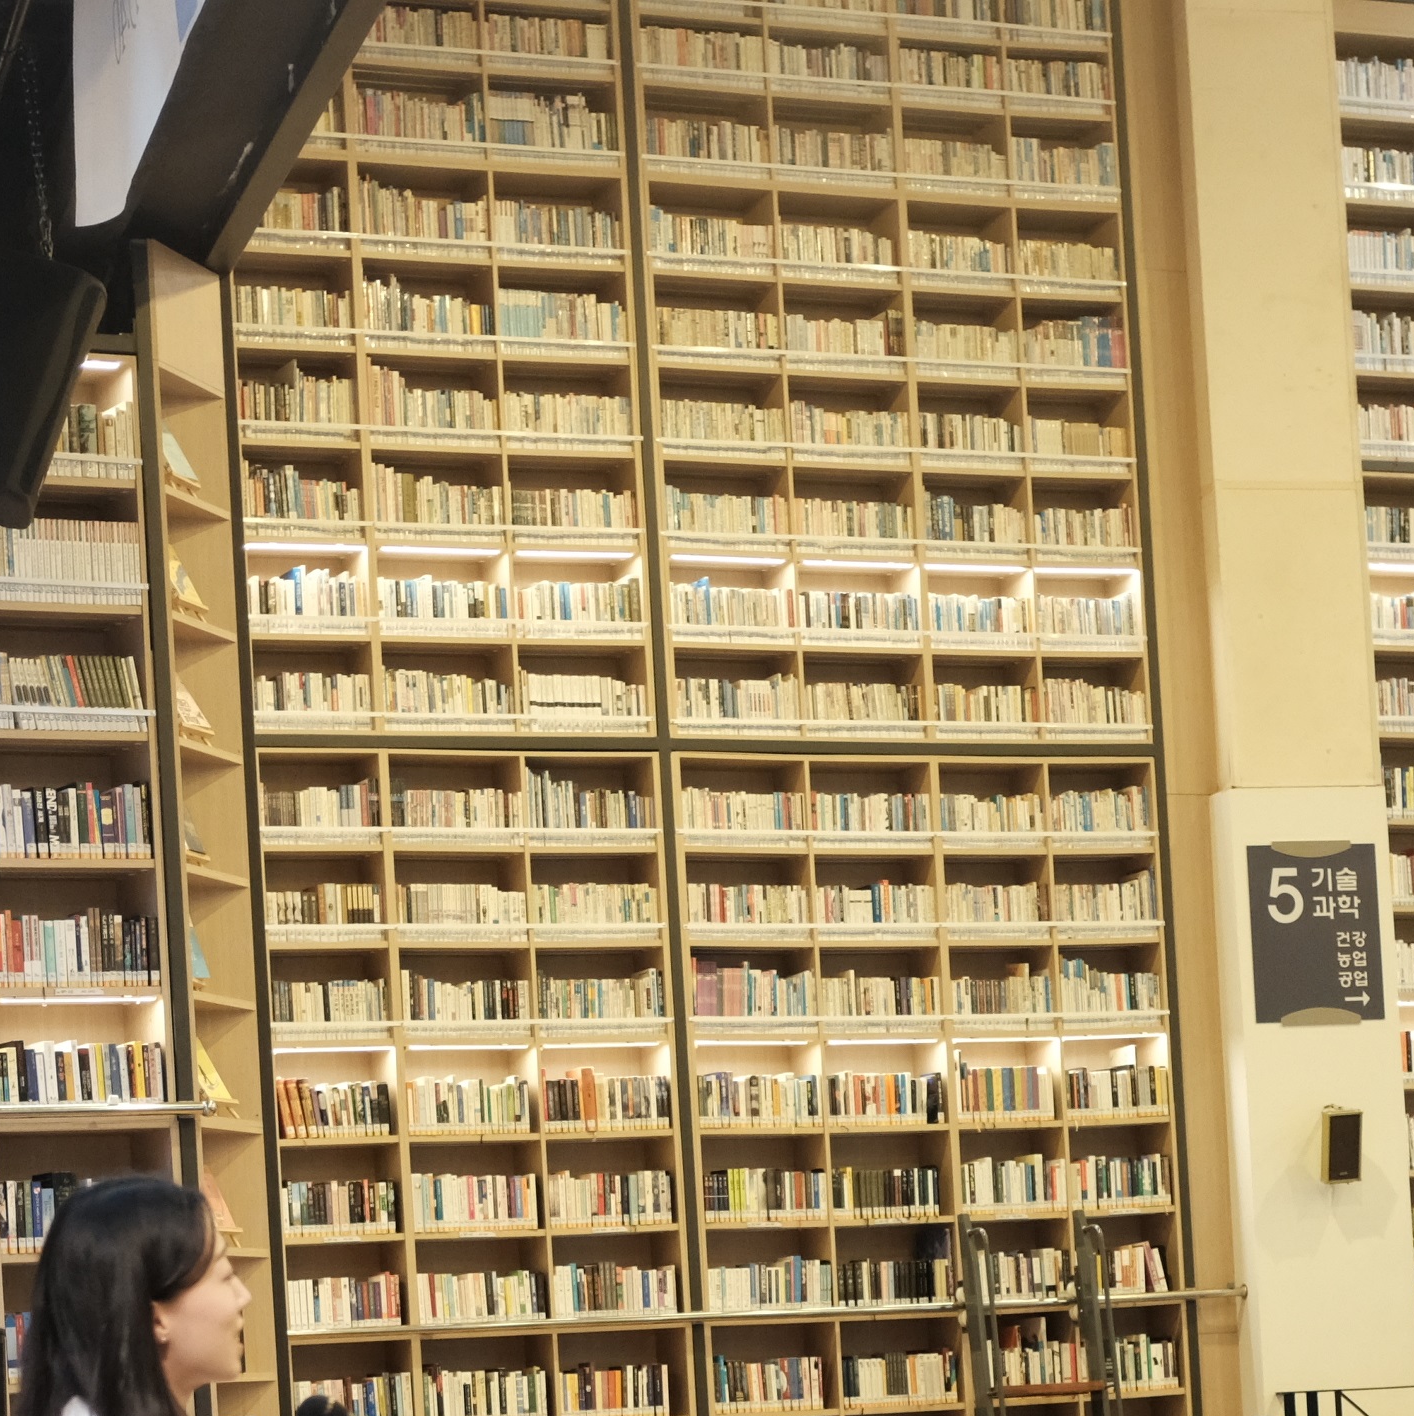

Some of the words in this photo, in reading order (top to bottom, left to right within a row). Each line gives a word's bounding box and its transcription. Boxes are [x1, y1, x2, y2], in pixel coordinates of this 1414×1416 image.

[1311, 867, 1358, 892] 기술
[1268, 867, 1304, 924] 5
[1312, 895, 1361, 919] 과학
[1336, 931, 1367, 948] 건강
[1337, 952, 1367, 968] 농업
[1338, 971, 1368, 988] 공업
